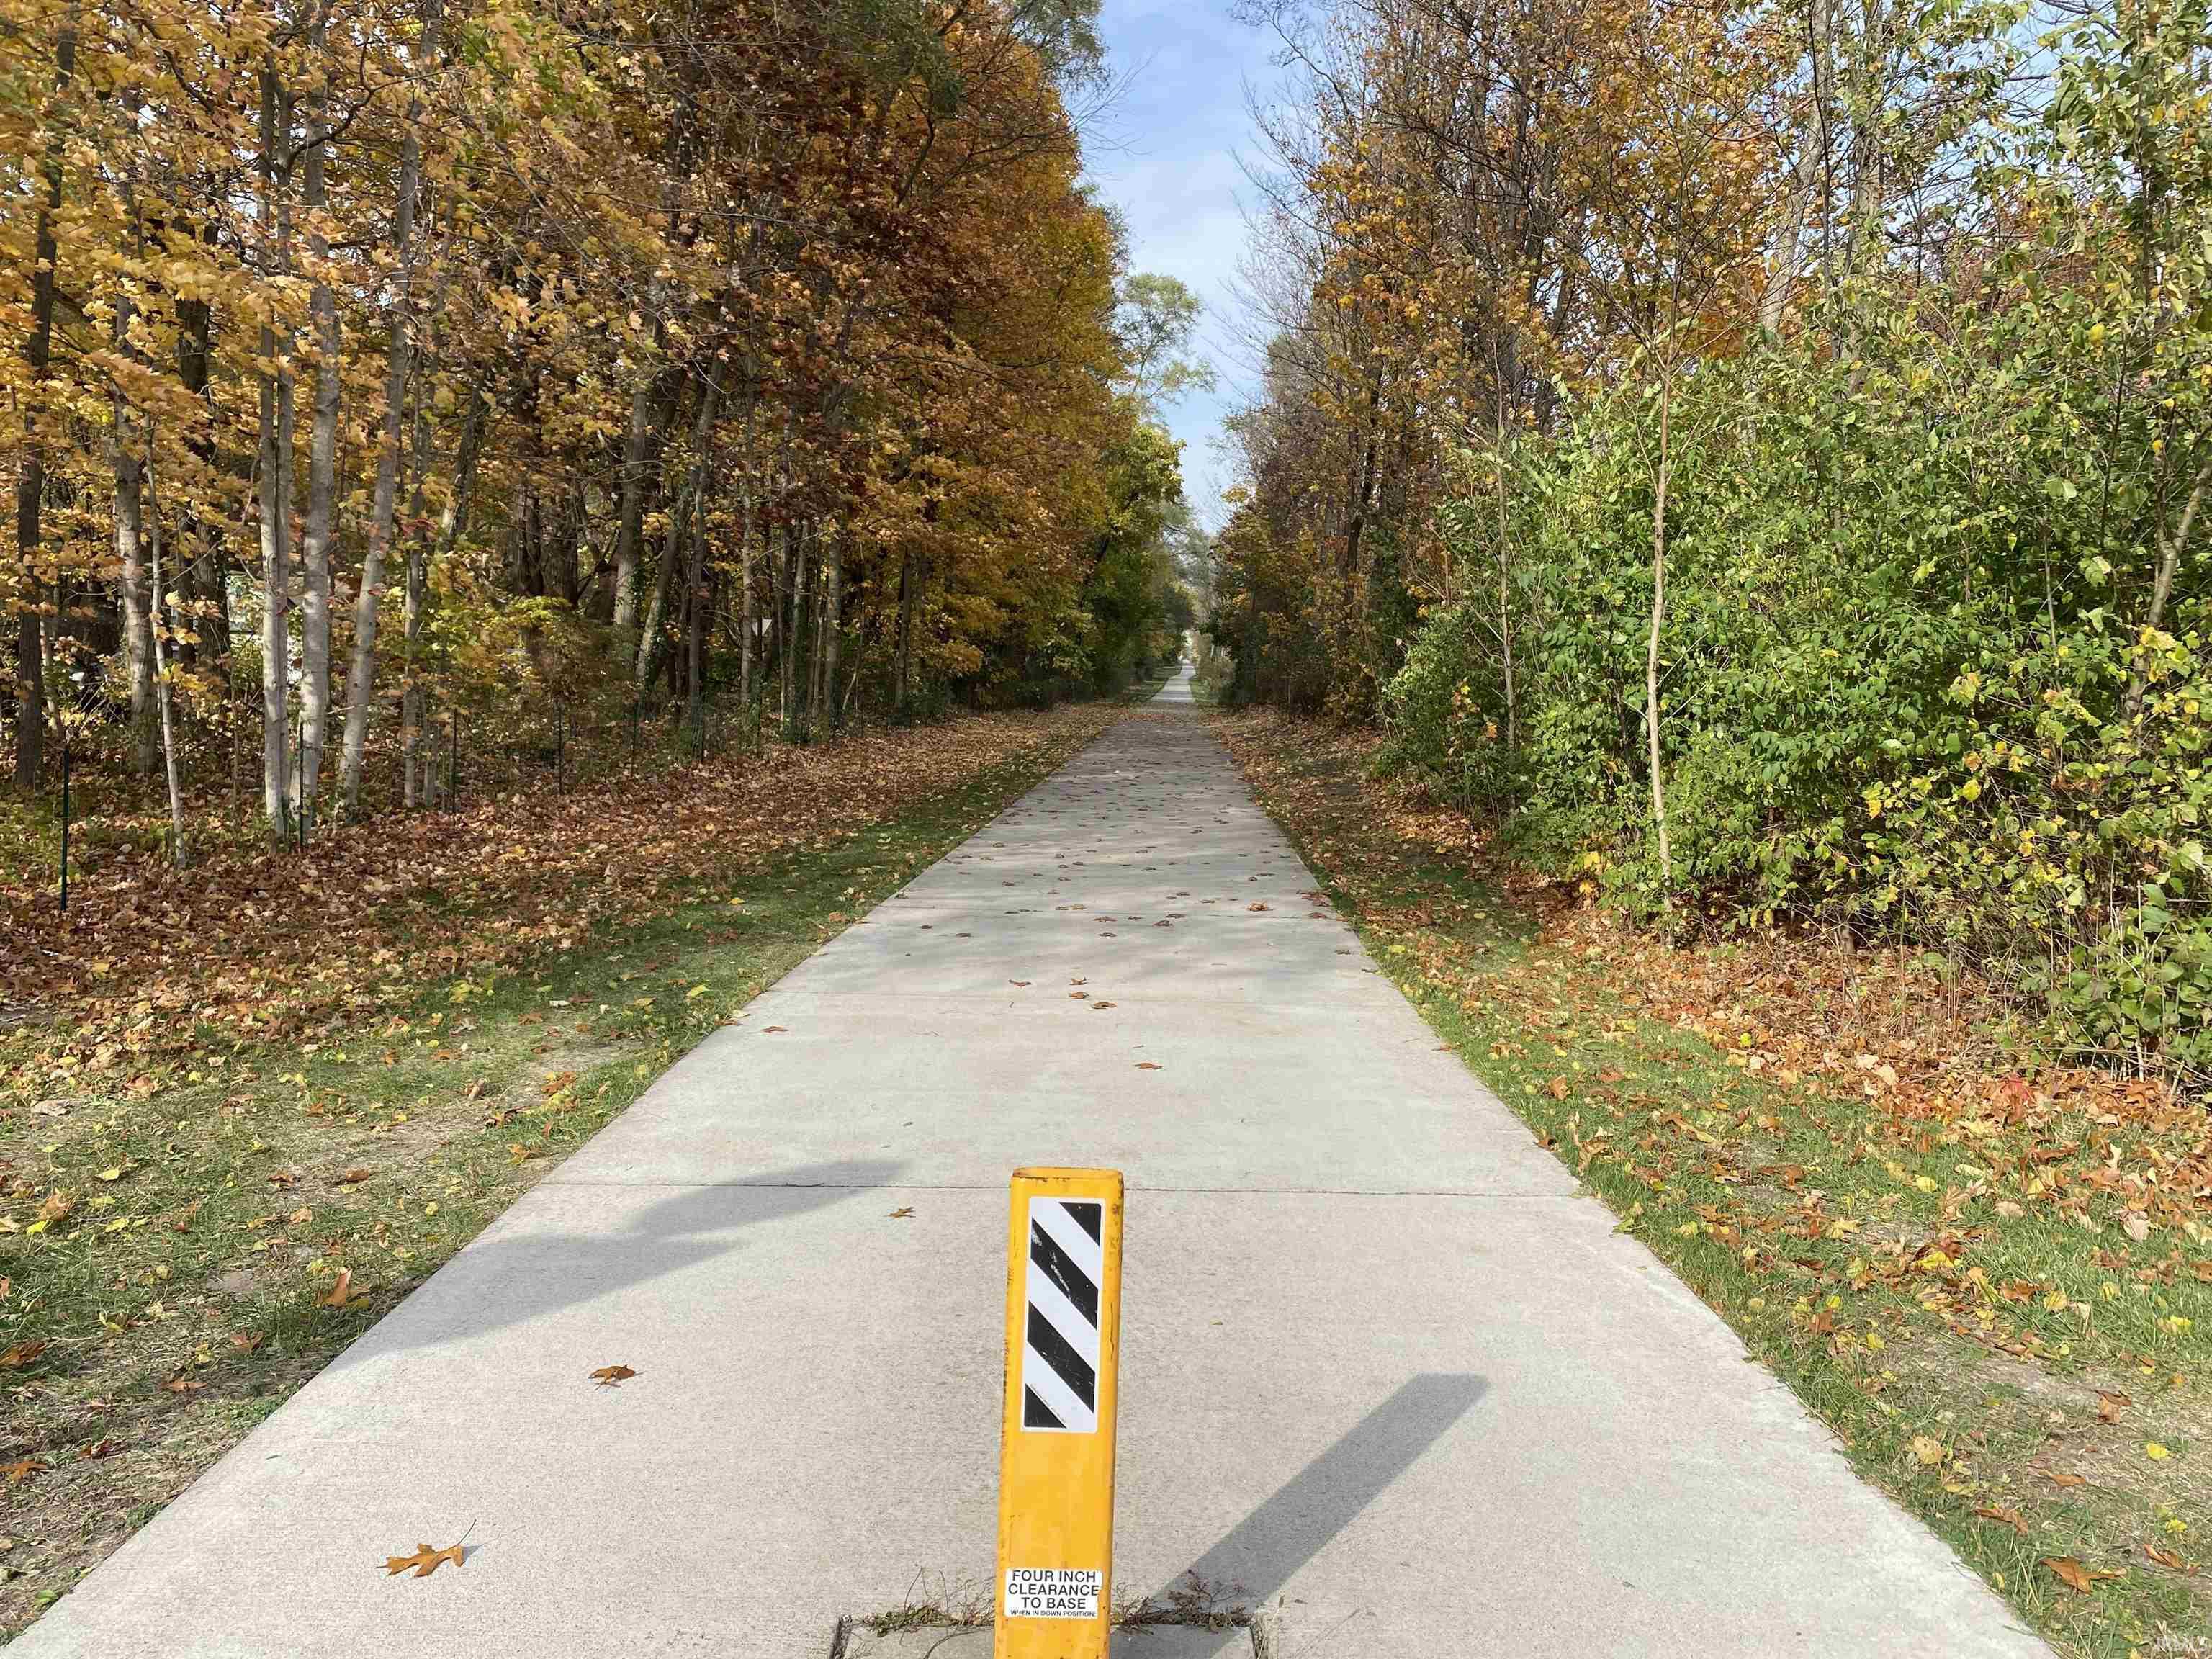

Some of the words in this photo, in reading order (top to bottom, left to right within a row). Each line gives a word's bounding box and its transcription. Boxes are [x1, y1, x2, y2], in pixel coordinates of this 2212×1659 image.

[1012, 1570, 1053, 1582] FOUR
[1059, 1570, 1096, 1583] INCH
[1008, 1583, 1100, 1596] CLEARANCE
[1021, 1597, 1041, 1609] TO
[1047, 1598, 1086, 1609] BASE
